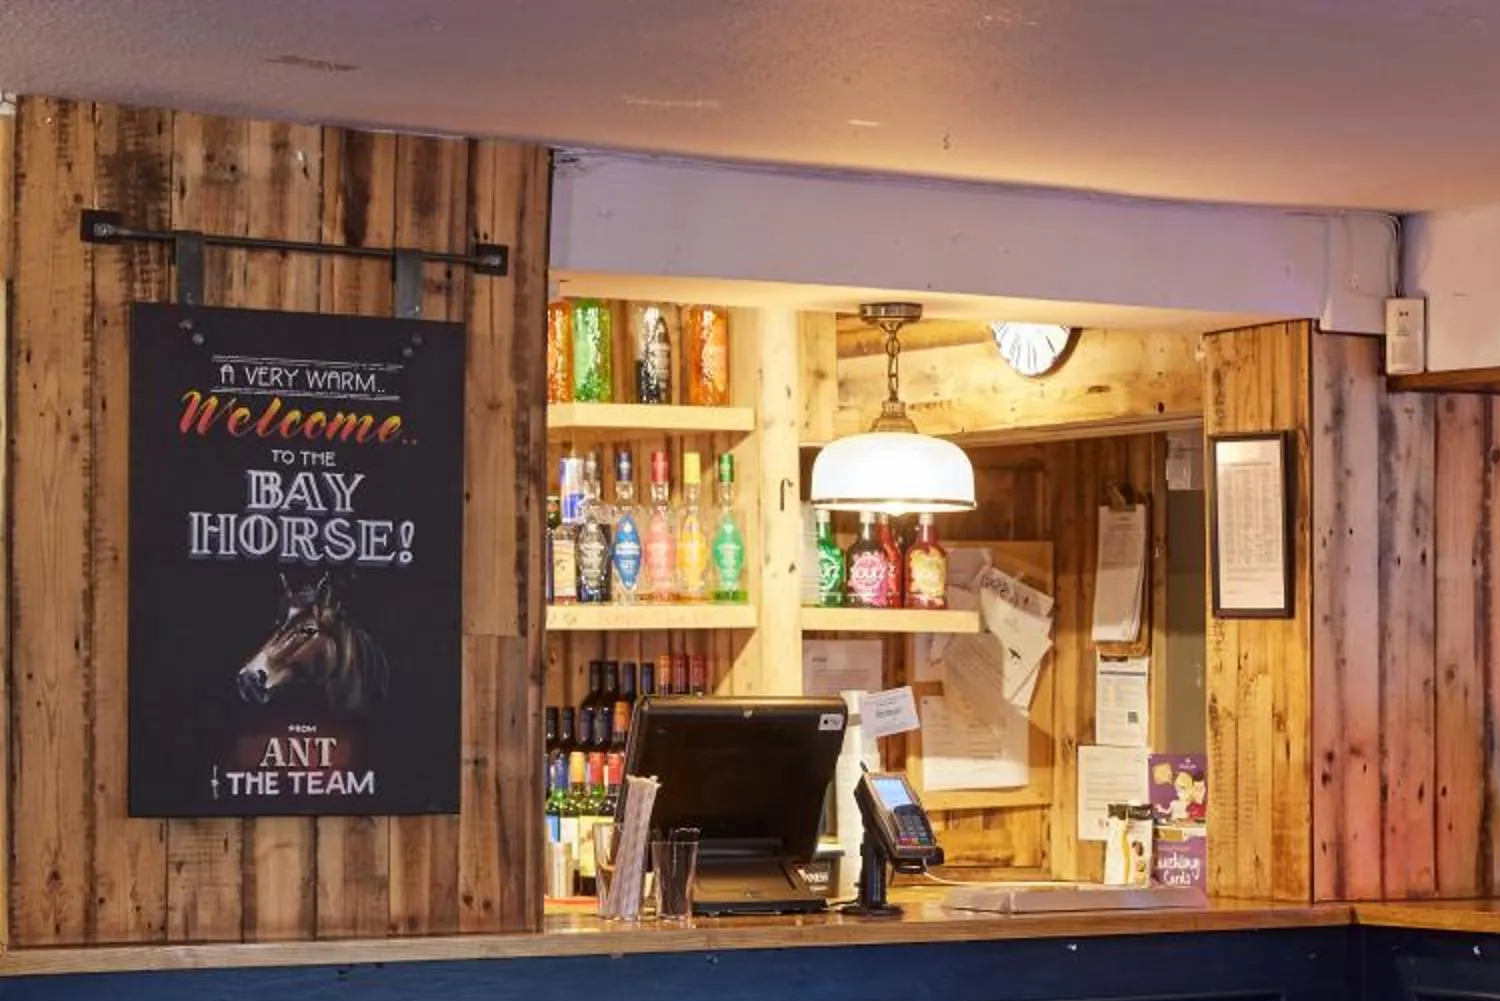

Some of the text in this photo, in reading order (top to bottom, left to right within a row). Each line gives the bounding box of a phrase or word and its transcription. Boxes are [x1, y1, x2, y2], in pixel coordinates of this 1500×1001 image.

[219, 363, 235, 384] A
[245, 366, 301, 388] VERY
[271, 448, 337, 468] TO THE
[246, 469, 366, 512] BAY
[188, 512, 416, 565] HORSE!
[259, 736, 337, 767] ANT
[226, 770, 281, 796] THE
[287, 770, 375, 796] TEAM
